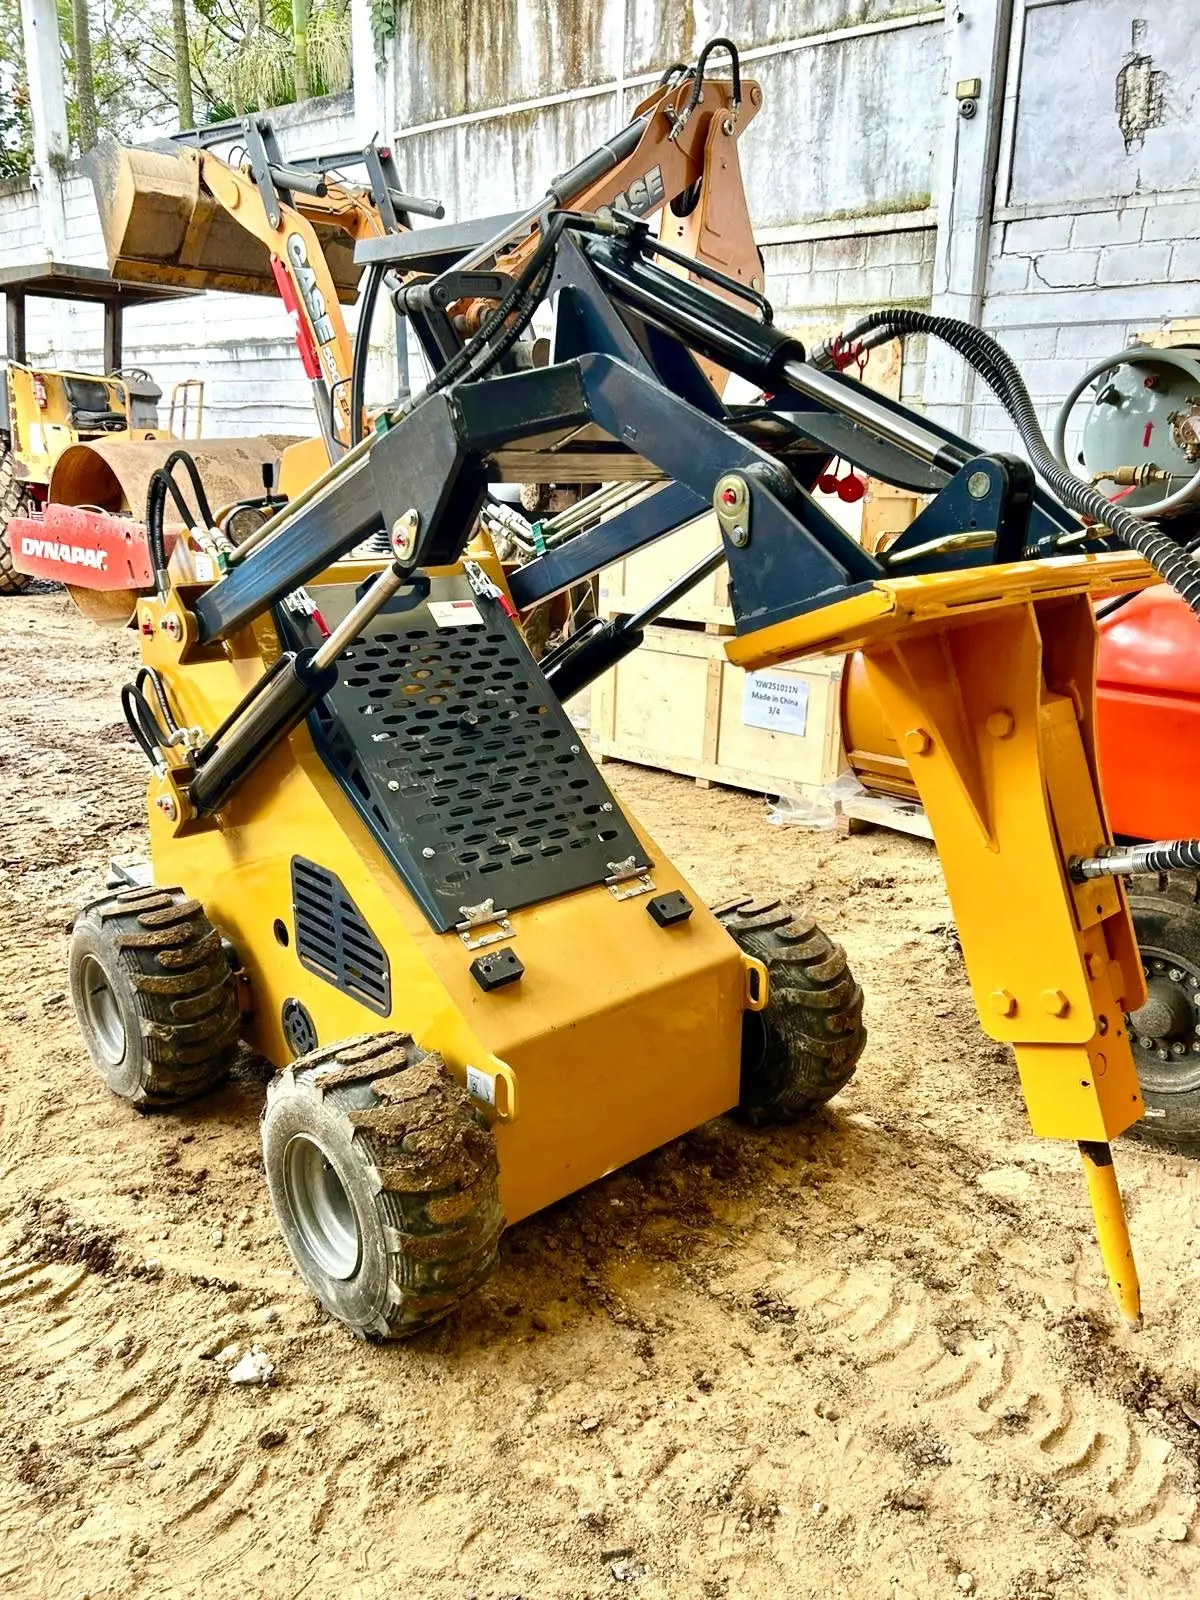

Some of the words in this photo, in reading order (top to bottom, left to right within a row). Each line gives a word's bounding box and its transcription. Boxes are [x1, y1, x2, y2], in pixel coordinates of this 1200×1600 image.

[287, 232, 336, 346] CASE
[21, 537, 108, 571] DYNAPAC
[755, 680, 799, 694] YJW251011N
[751, 691, 771, 702] Made
[772, 695, 779, 703] in
[780, 696, 799, 707] China
[768, 706, 781, 715] 3/4
